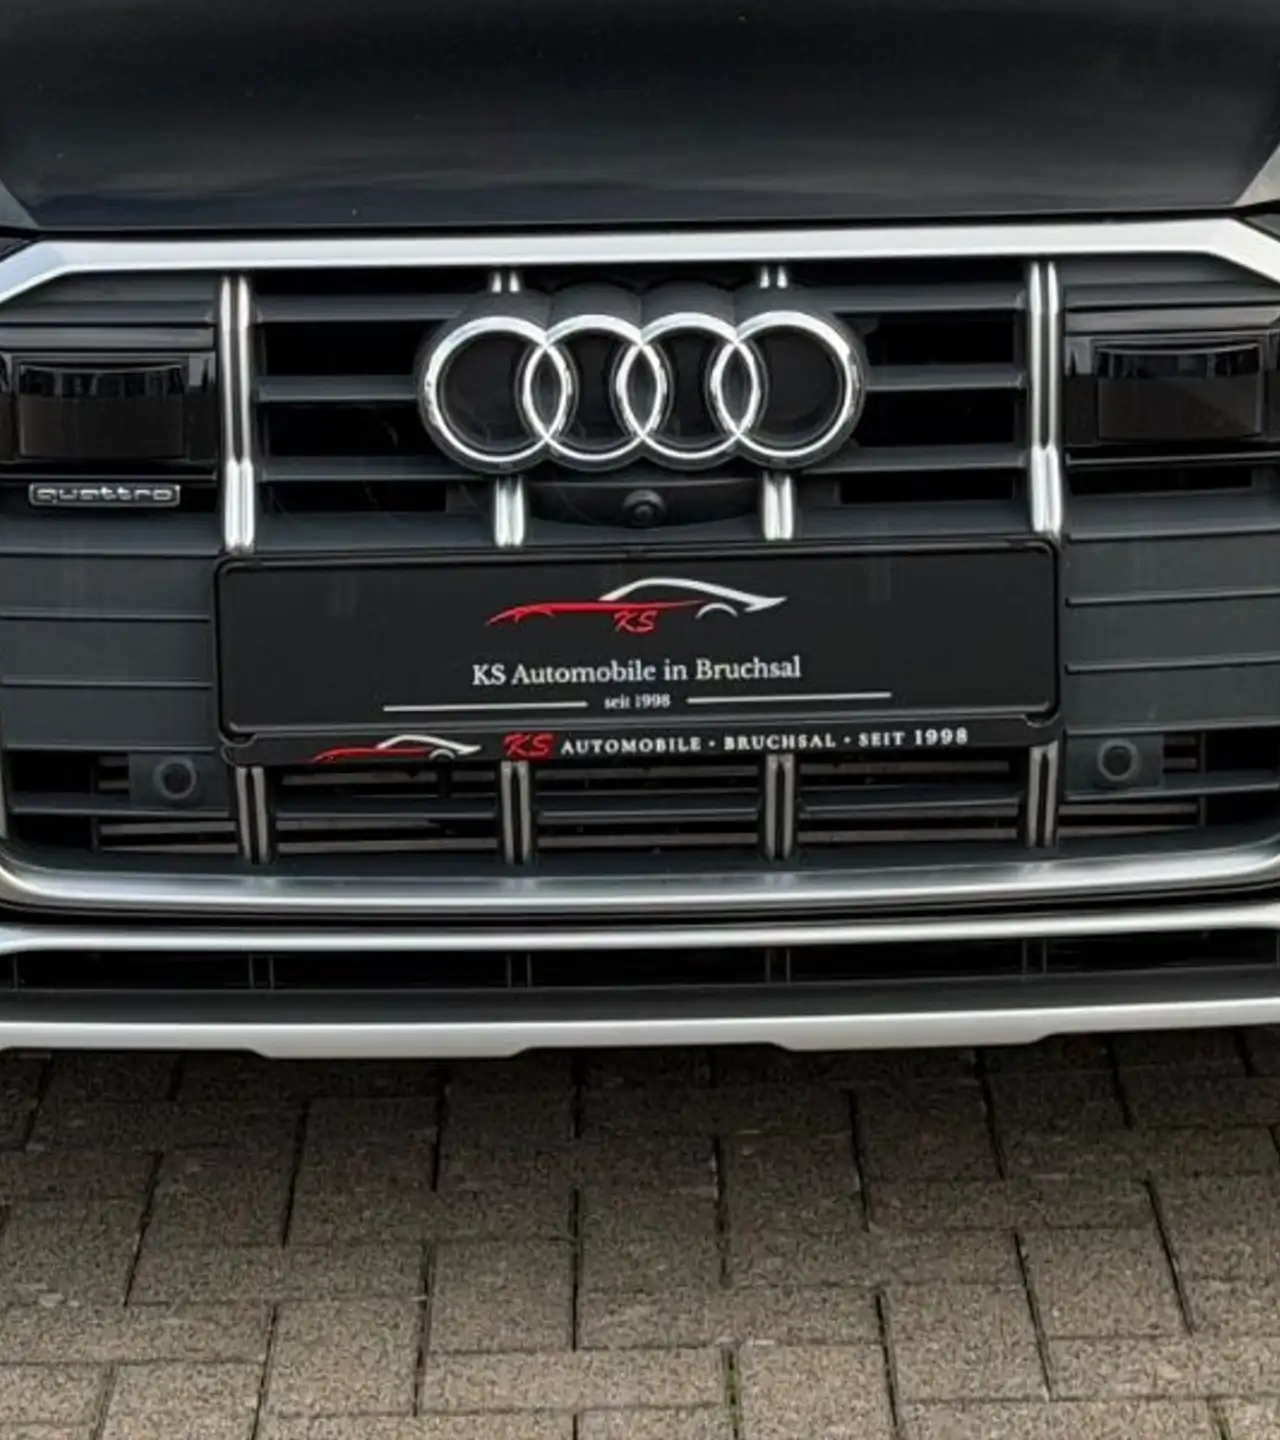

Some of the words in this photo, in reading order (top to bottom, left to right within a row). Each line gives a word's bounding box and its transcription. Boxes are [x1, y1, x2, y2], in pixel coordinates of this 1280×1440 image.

[36, 486, 174, 504] quattro
[613, 610, 657, 633] KS
[472, 663, 506, 686] KS
[511, 659, 656, 685] Automobile
[664, 658, 688, 681] in
[695, 655, 802, 681] Bruchsal
[604, 694, 630, 709] seit
[635, 693, 671, 708] 1998
[502, 733, 555, 758] KS
[561, 737, 702, 755] AUTOMOBILE
[723, 733, 836, 751] BRUCHSAL
[858, 731, 904, 747] SEIT
[914, 728, 969, 746] 1998
